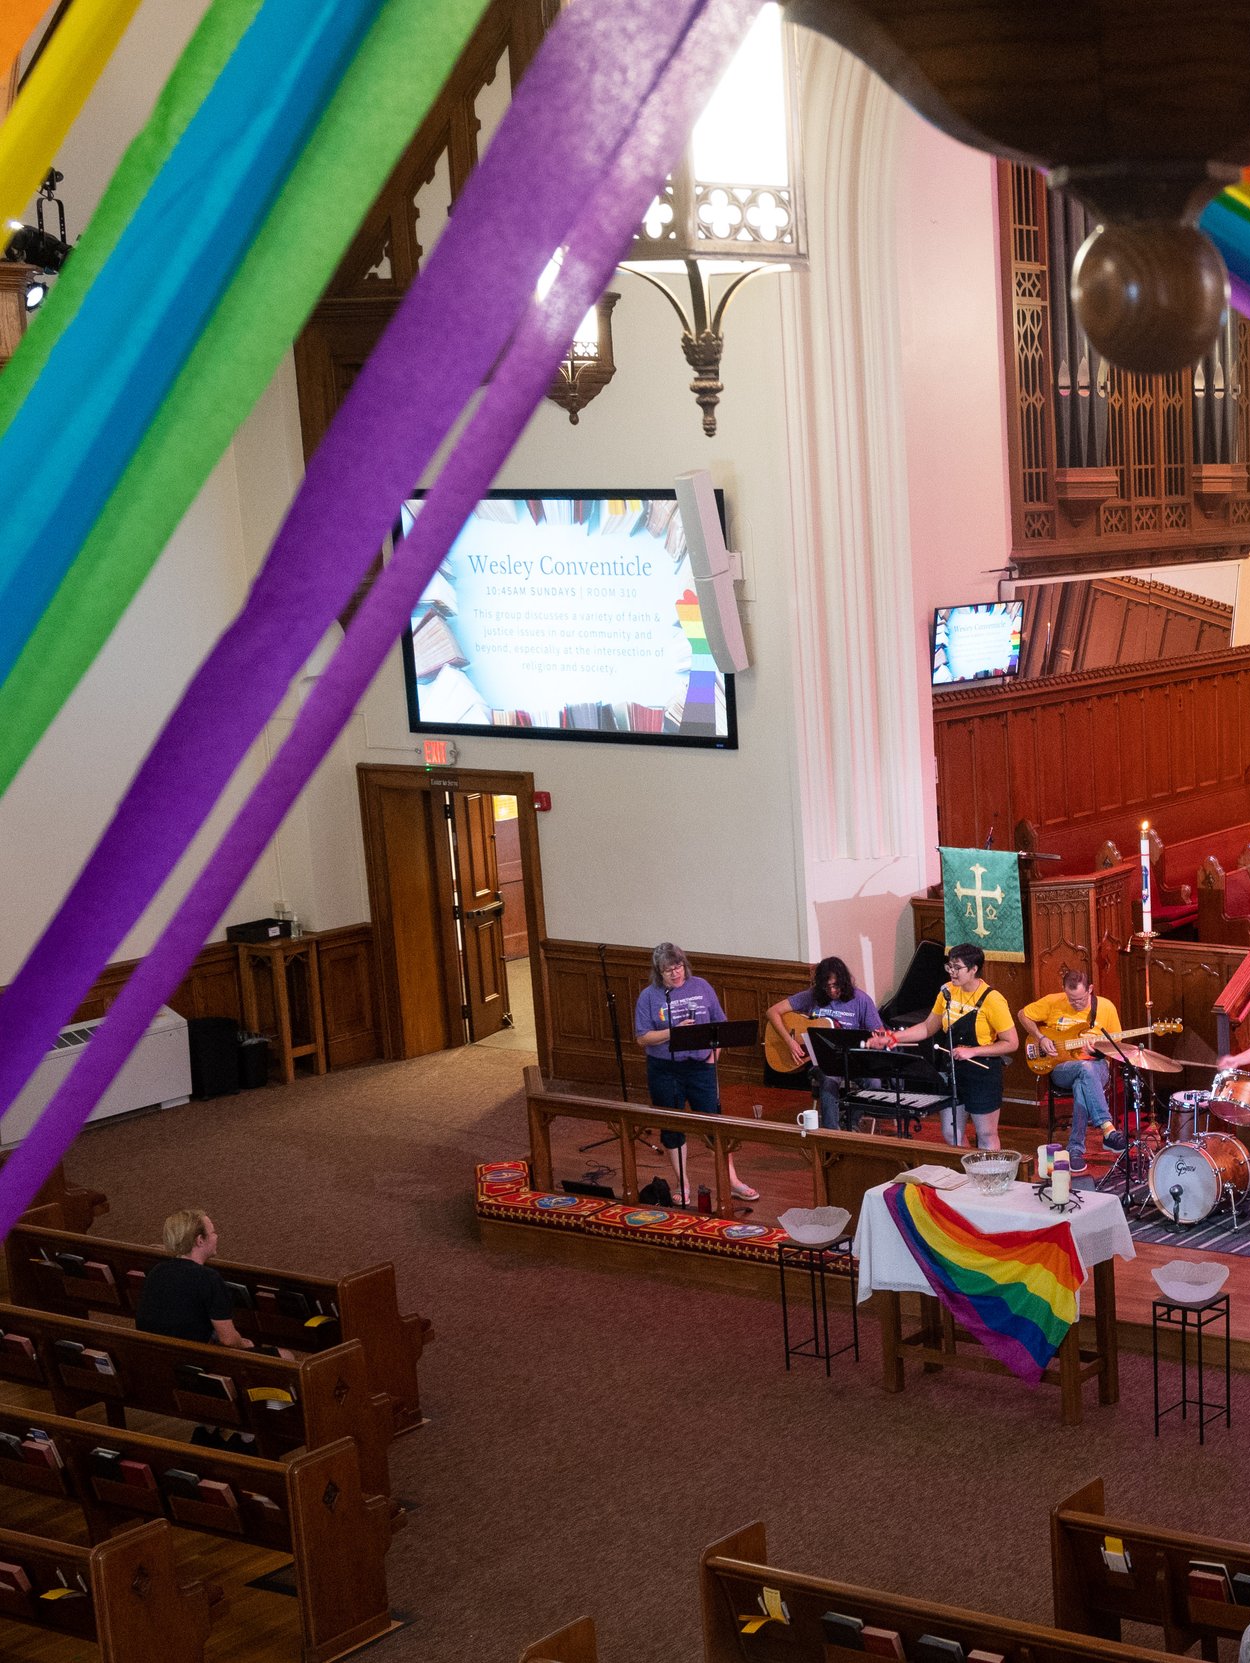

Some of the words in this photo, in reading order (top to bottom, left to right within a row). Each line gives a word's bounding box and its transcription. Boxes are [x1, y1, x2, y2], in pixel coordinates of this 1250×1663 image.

[468, 554, 533, 580] Wesley
[539, 555, 652, 576] Conventicle
[486, 585, 526, 596] 10:45AM
[530, 586, 576, 597] SUNDAYS
[586, 587, 616, 598] ROOM
[619, 588, 637, 598] 310
[473, 608, 493, 619] This
[495, 610, 522, 621] group
[524, 610, 569, 621] discusses
[580, 612, 613, 623] variety
[616, 613, 626, 622] of
[628, 613, 651, 622] faith
[654, 613, 661, 622] &
[483, 626, 514, 639] justice
[517, 628, 545, 637] issues
[548, 628, 556, 637] in
[560, 629, 575, 637] our
[578, 629, 631, 641] community
[634, 630, 652, 640] and
[514, 645, 560, 656] especially
[563, 646, 573, 655] at
[575, 646, 591, 655] the
[594, 646, 651, 657] intersection
[655, 647, 664, 657] of
[521, 662, 557, 673] religion
[560, 662, 577, 671] and
